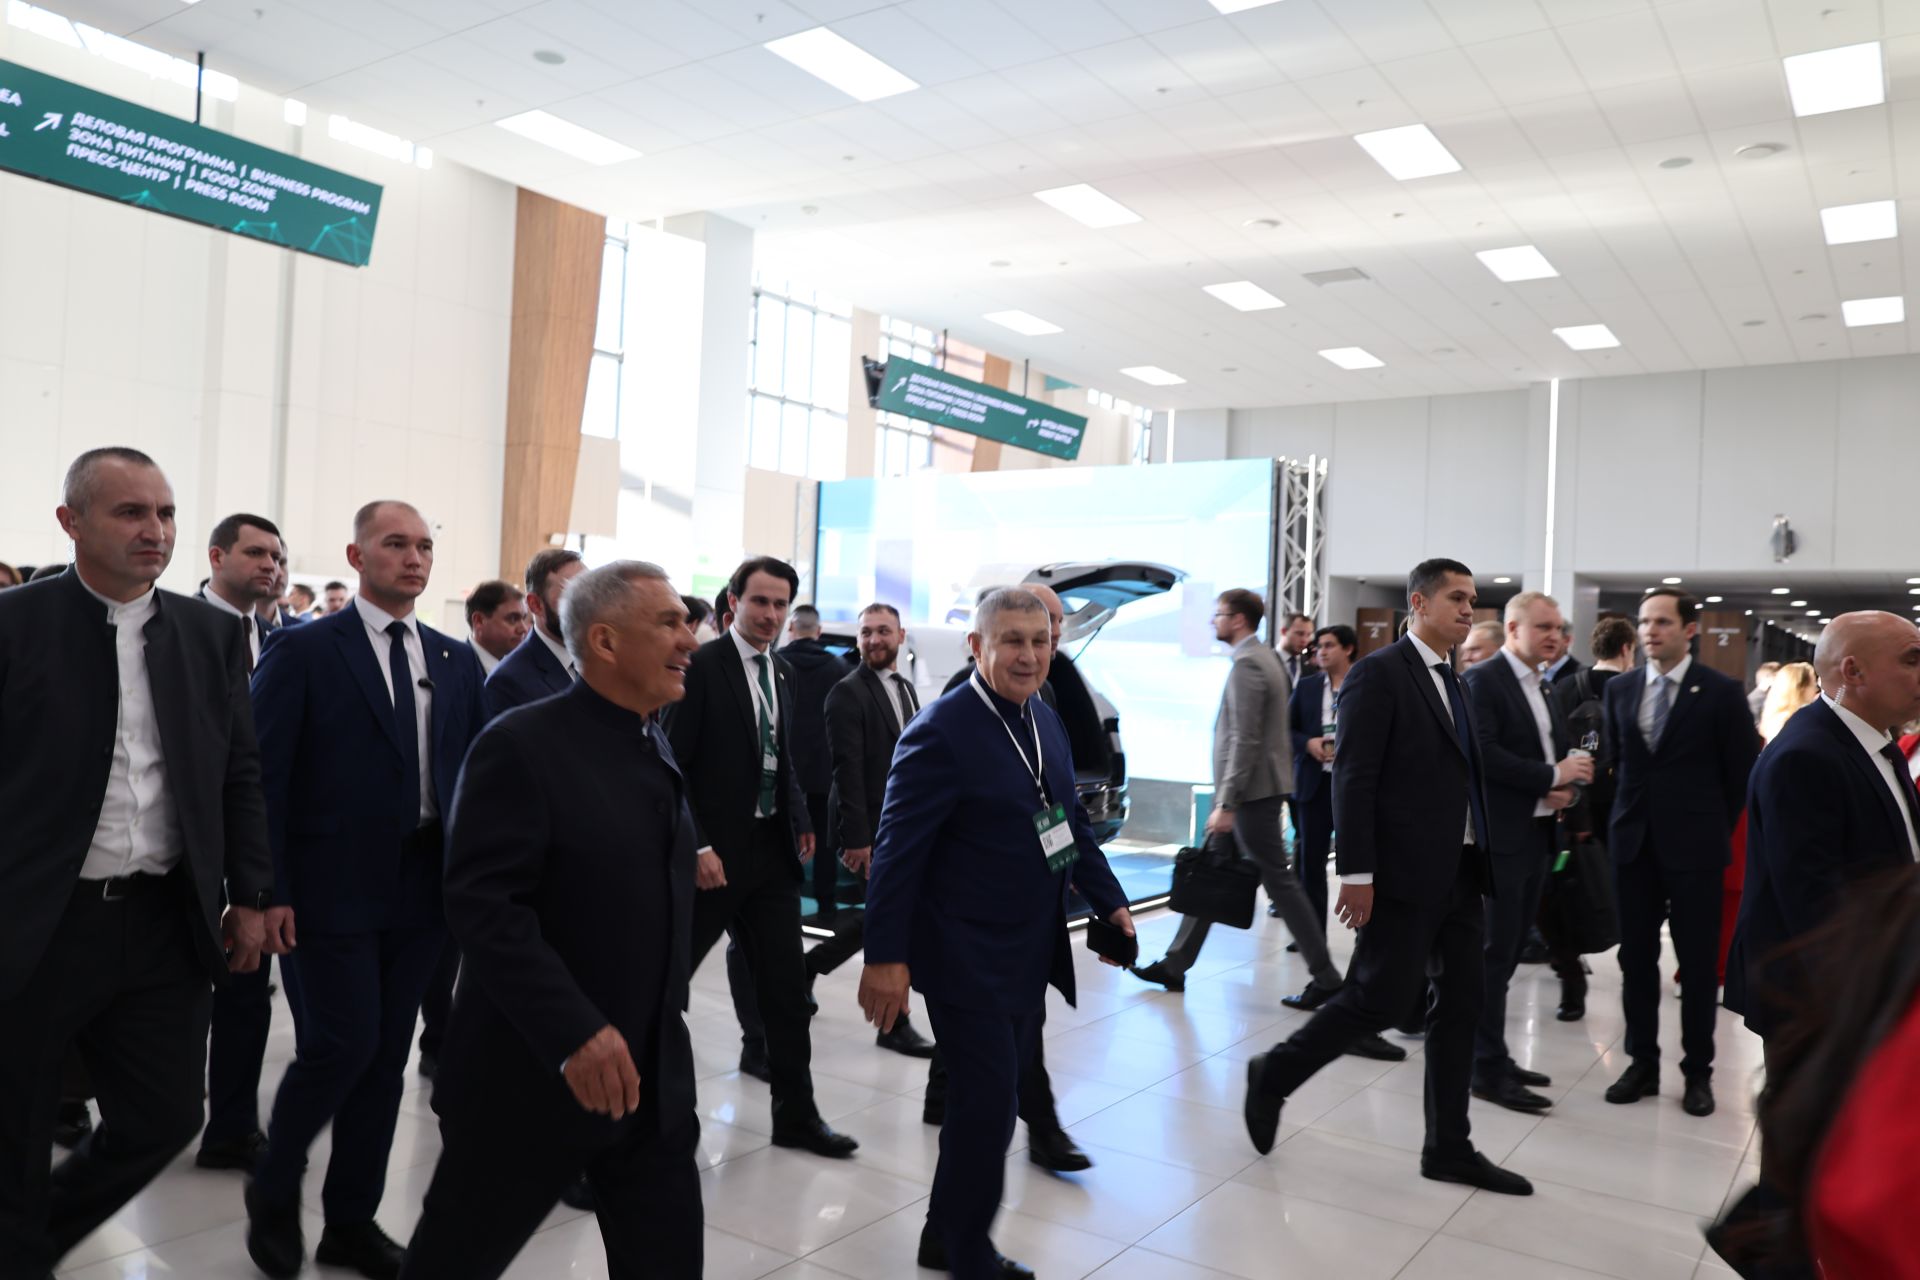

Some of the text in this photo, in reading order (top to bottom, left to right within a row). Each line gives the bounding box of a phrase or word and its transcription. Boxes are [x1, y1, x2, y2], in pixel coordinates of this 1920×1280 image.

[66, 143, 172, 183] ПРЕСС-ЦЕНТР
[184, 178, 229, 202] PRESS
[227, 191, 271, 214] ROOM
[68, 127, 114, 152] ЗОНА
[114, 141, 187, 173] ПИТАНИЯ
[200, 167, 241, 190] FOOD
[239, 179, 278, 202] ZONE
[70, 111, 148, 145] ДЕЛОВАЯ
[146, 135, 237, 174] ПРОГРАММА
[250, 167, 313, 198] BUSINESS
[310, 187, 371, 216] PROGRAM
[1717, 633, 1729, 647] 2
